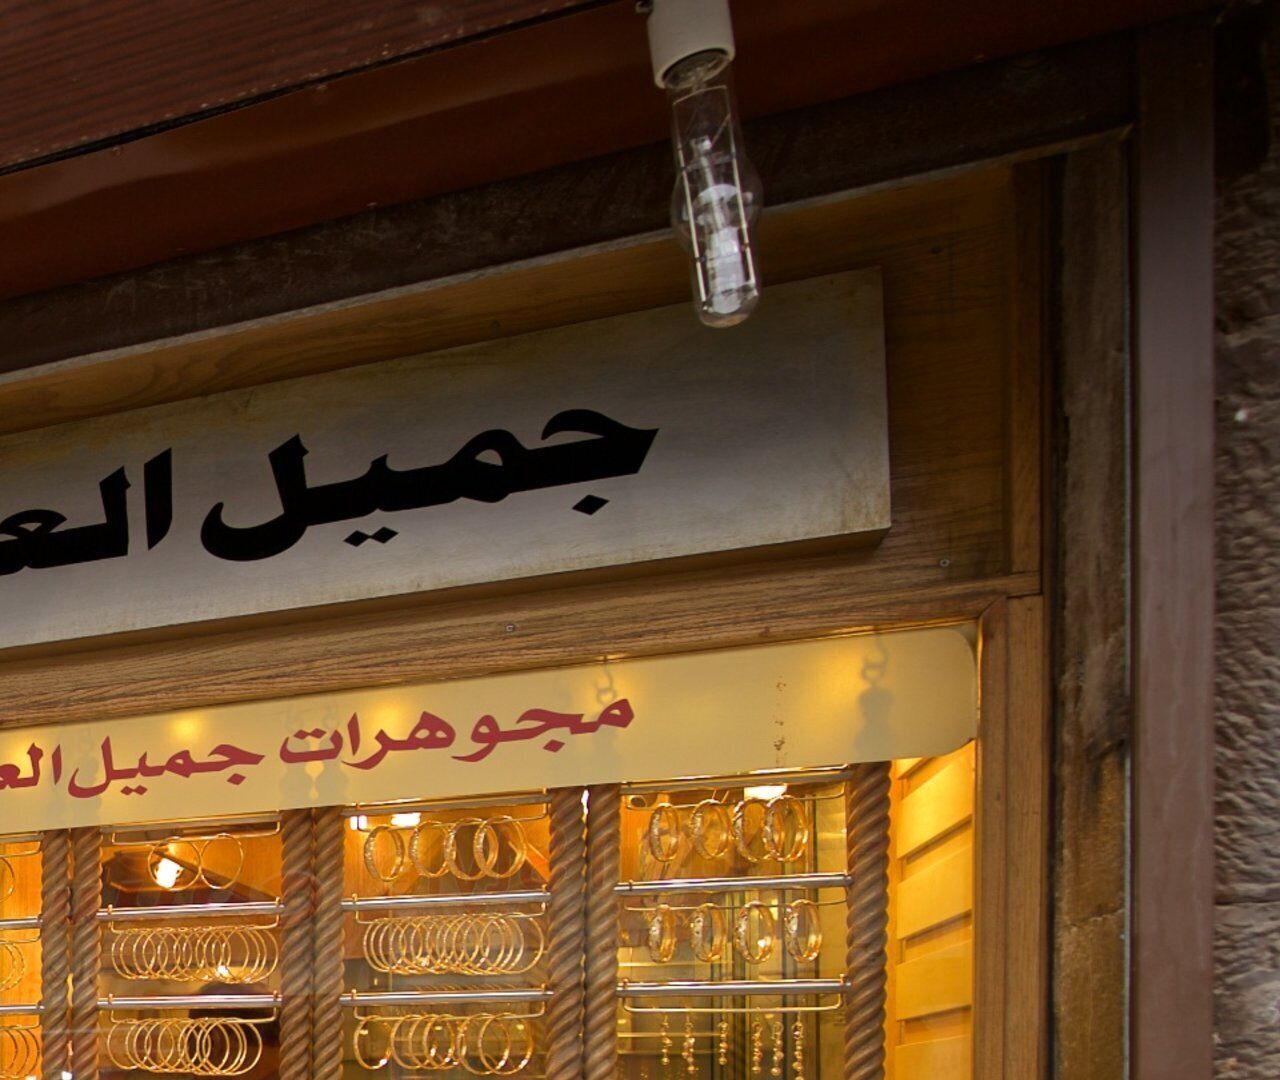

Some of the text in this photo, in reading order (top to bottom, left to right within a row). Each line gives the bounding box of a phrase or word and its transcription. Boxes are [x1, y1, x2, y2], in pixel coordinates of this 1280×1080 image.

[200, 408, 659, 564] جميل
[67, 735, 264, 799] جميل
[281, 697, 635, 771] مجوهرات
